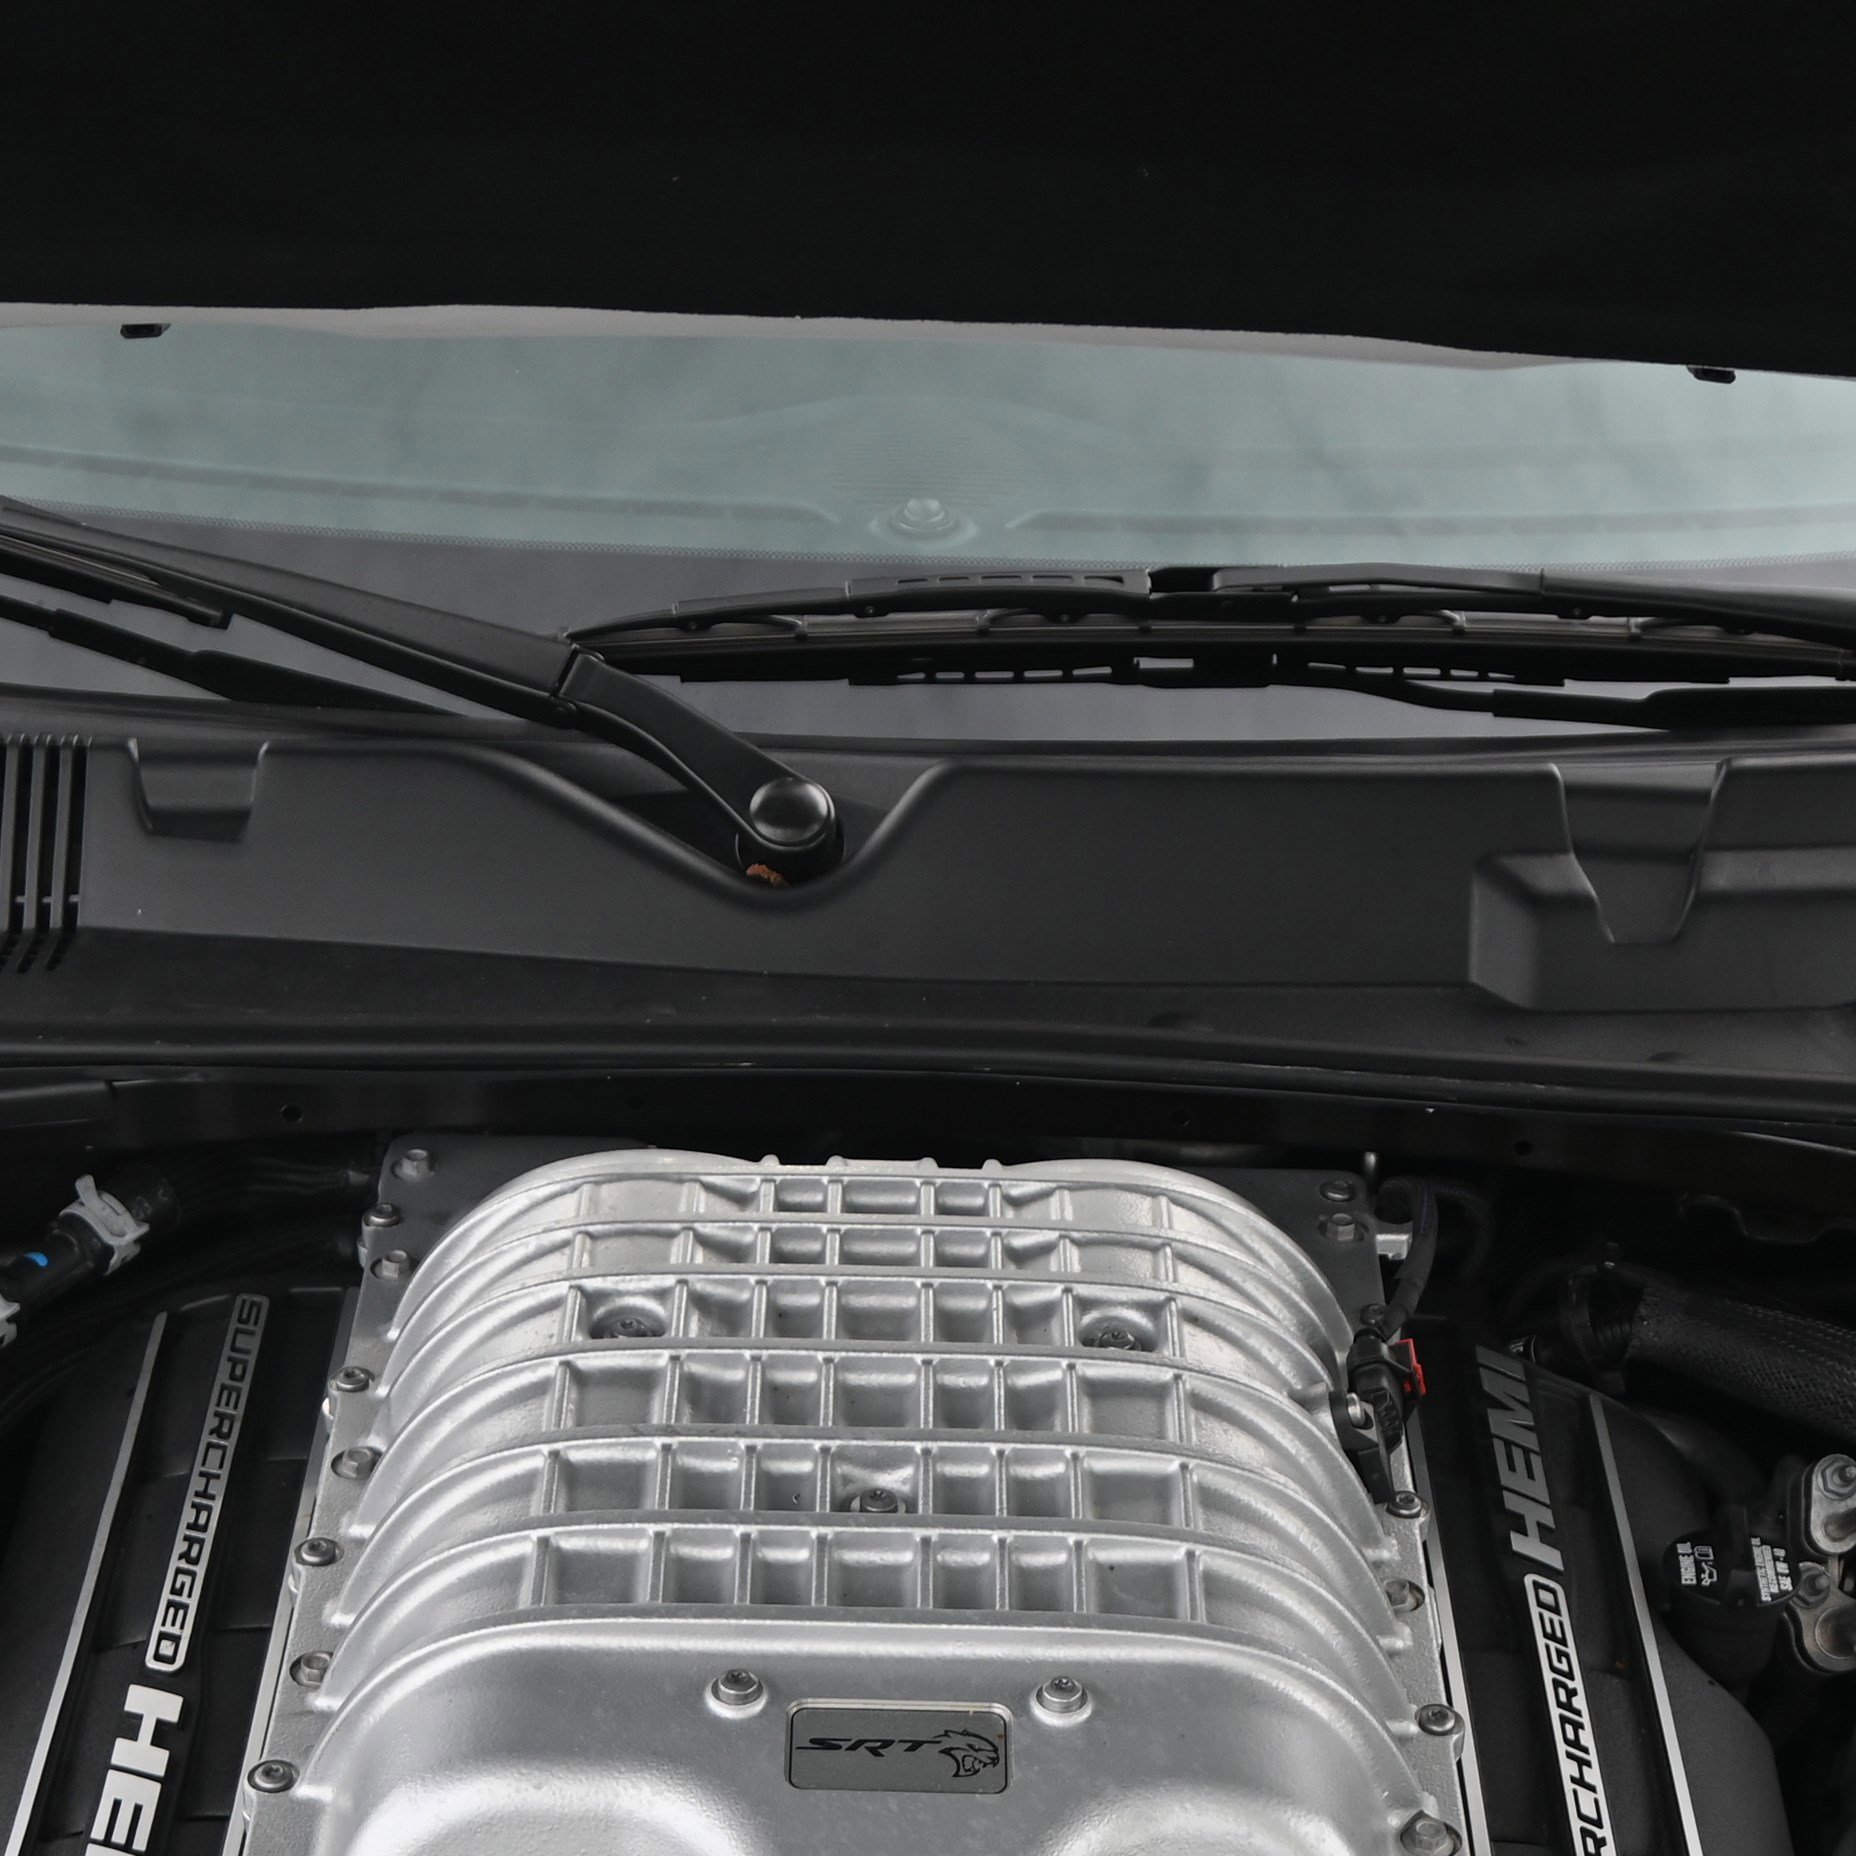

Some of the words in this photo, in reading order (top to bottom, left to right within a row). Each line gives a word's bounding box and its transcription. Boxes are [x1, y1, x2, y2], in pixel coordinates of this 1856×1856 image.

[1477, 1346, 1565, 1572] HEMI
[150, 1296, 266, 1665] SUPERCHARGED
[1676, 1541, 1693, 1554] OIL
[1678, 1555, 1697, 1585] ENGINE
[1777, 1575, 1794, 1592] SAE
[794, 1737, 943, 1758] SRT
